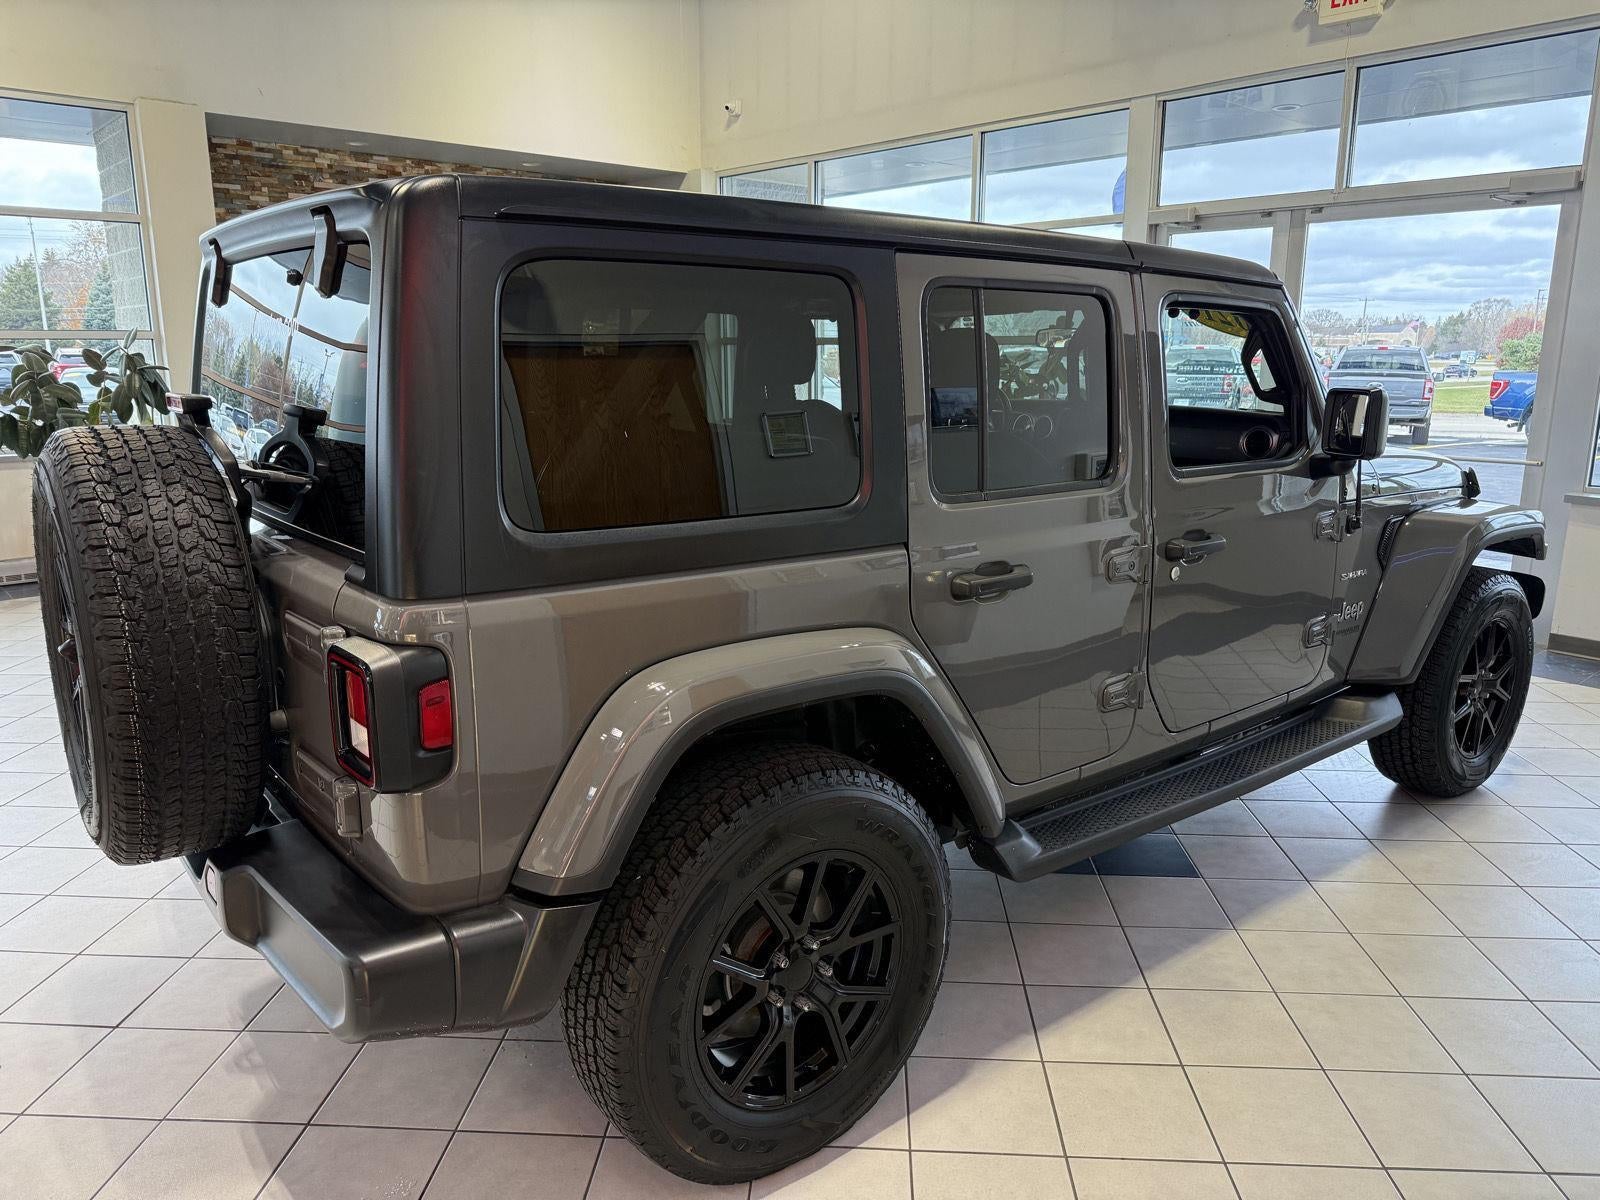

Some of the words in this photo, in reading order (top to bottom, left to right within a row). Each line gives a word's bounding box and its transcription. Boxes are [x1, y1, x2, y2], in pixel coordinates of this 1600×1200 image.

[1337, 601, 1364, 621] Jeep
[856, 817, 937, 997] WRANGLER
[667, 964, 779, 1154] GOODYEAR
